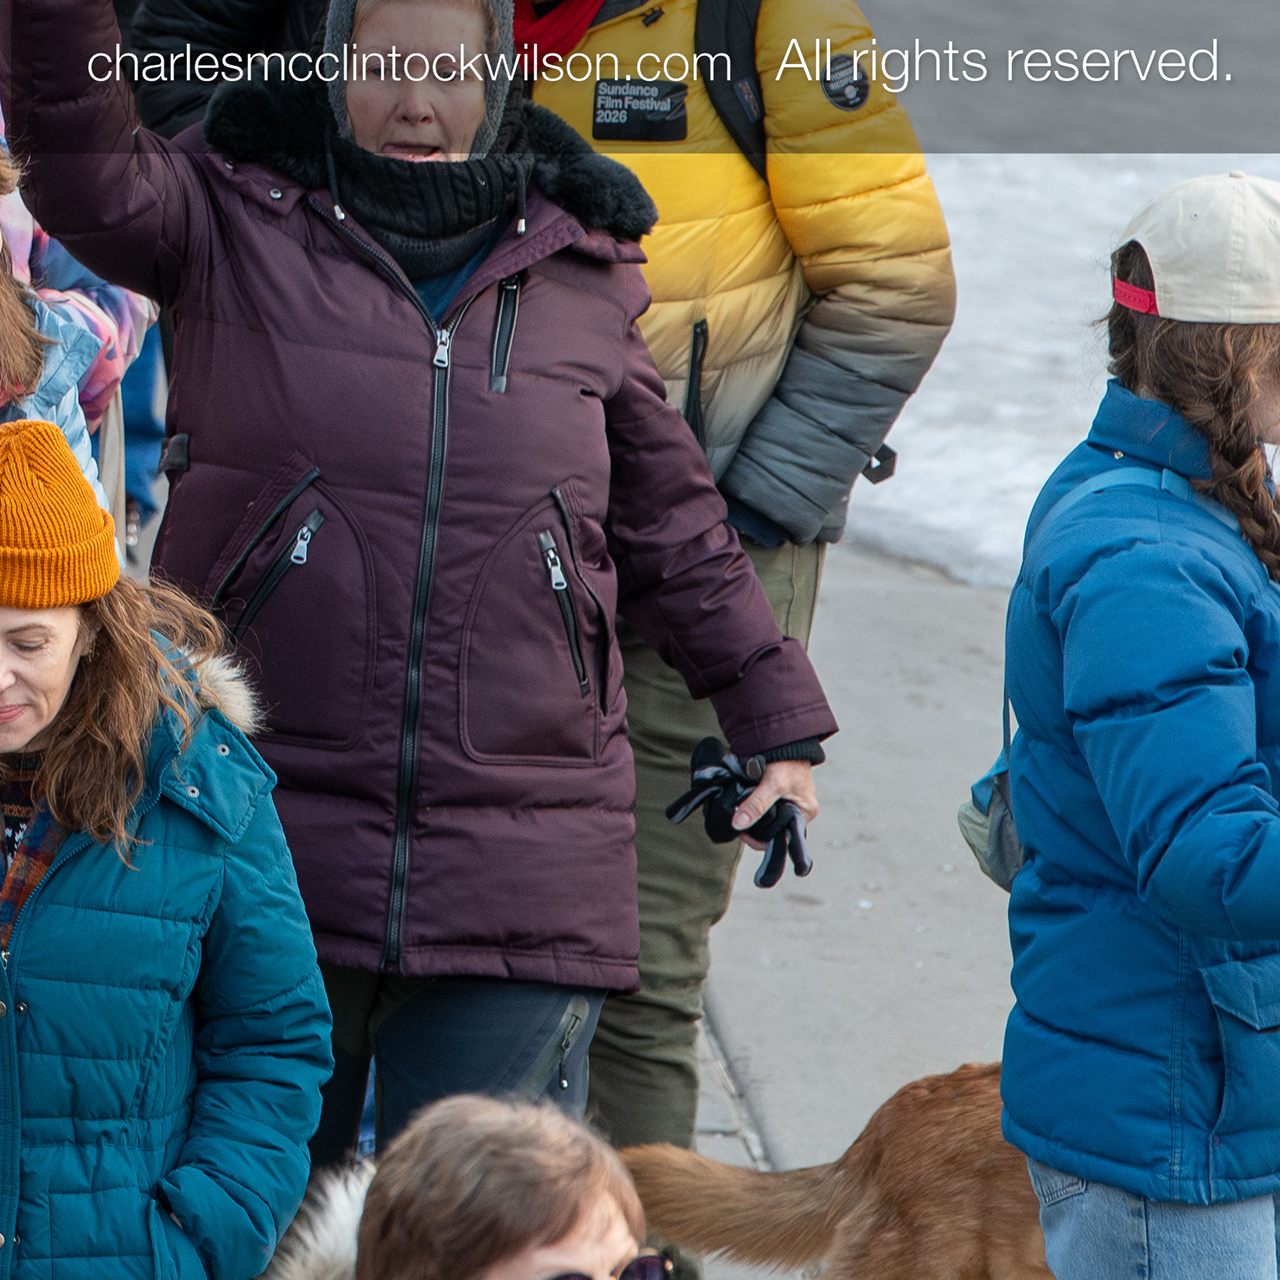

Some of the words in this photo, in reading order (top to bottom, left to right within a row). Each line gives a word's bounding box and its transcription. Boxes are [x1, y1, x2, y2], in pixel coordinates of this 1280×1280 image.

[599, 82, 659, 97] Sundance
[597, 96, 622, 109] Film
[624, 96, 671, 112] Festival
[596, 110, 628, 123] 2026
